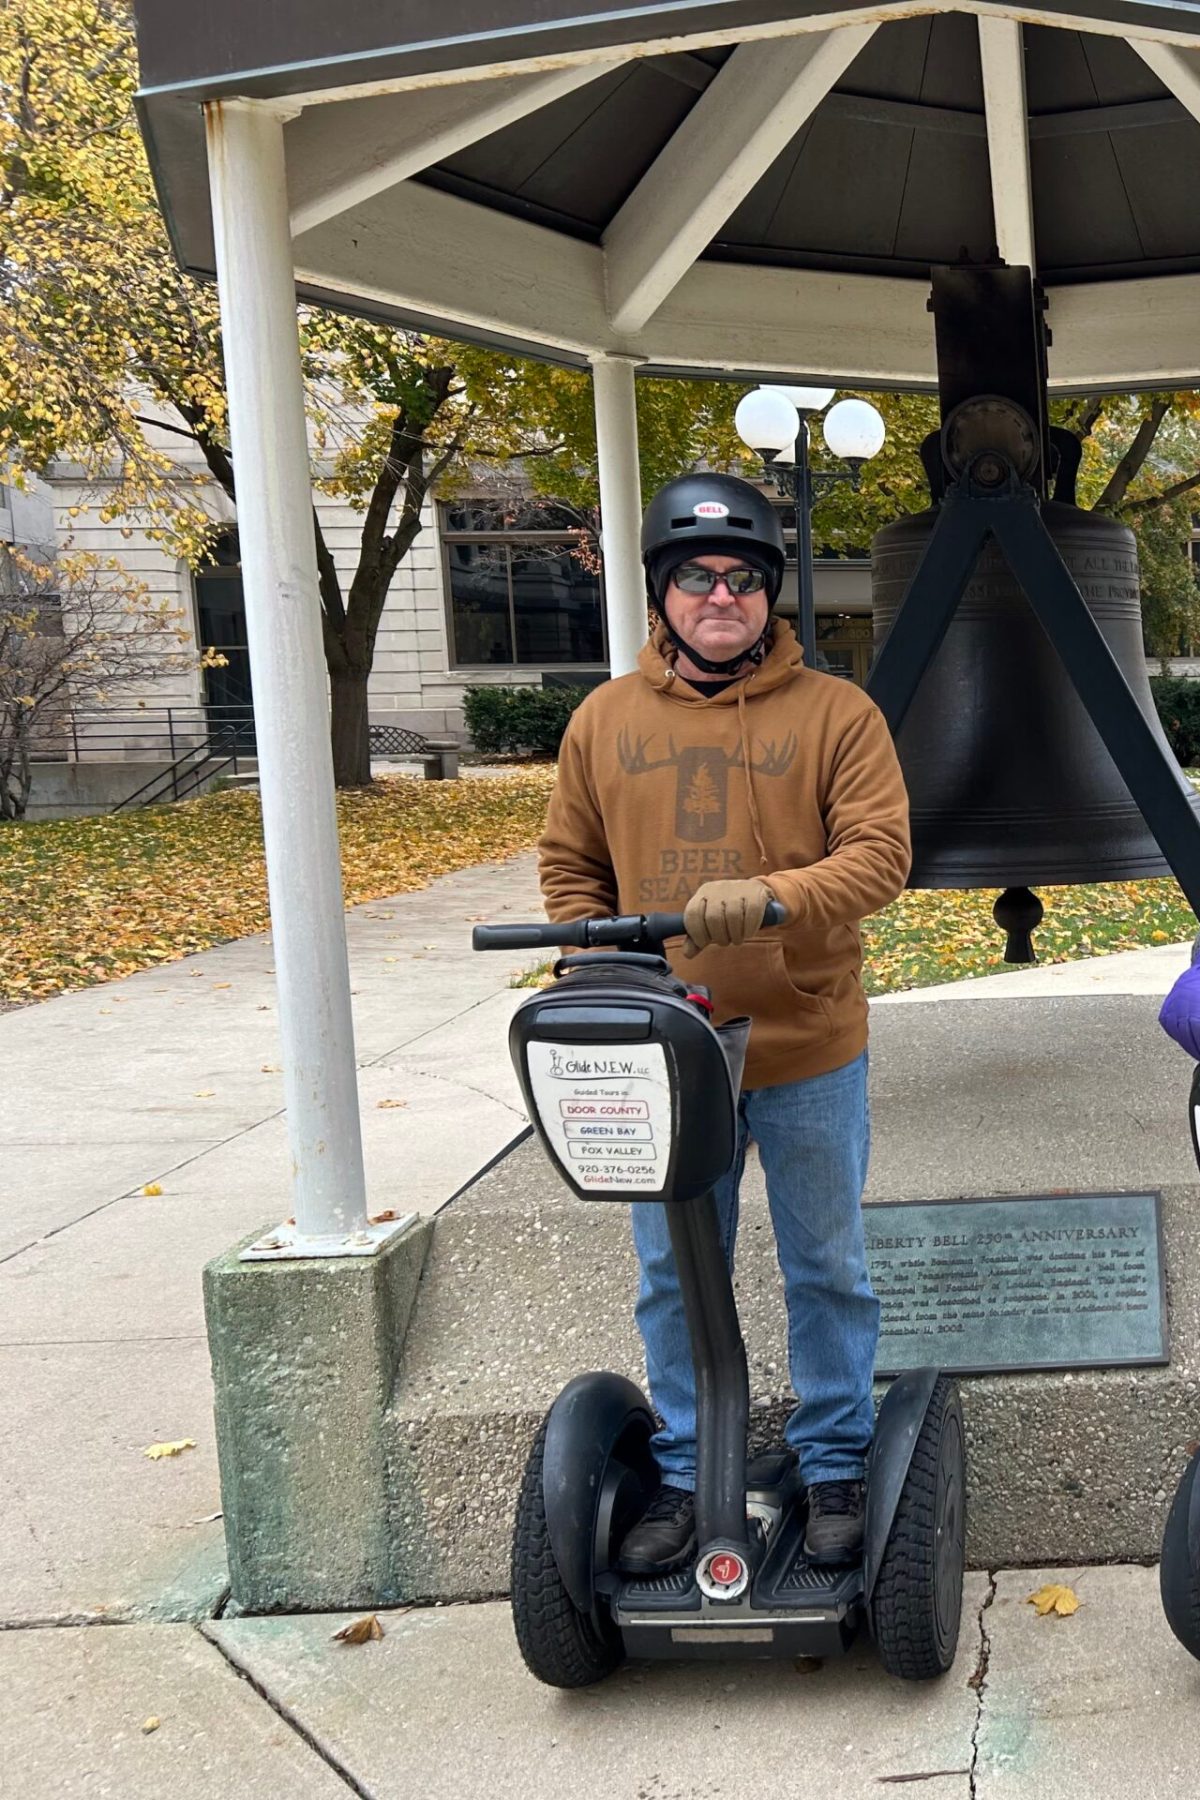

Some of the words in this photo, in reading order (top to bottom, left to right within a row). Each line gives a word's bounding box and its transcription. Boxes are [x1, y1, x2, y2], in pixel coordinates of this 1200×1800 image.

[1084, 557, 1108, 571] ALL
[660, 848, 743, 874] BEER
[565, 1060, 591, 1074] Glide
[567, 1106, 596, 1114] DOOR
[600, 1106, 642, 1115] COUNTY
[580, 1127, 613, 1135] GREEN
[617, 1127, 636, 1135] BAY
[581, 1146, 603, 1155] FOX
[606, 1146, 642, 1155] VALLEY
[578, 1165, 656, 1174] 920-376-0256
[584, 1175, 656, 1185] GlideNew.com
[933, 1234, 968, 1247] BELL
[1019, 1227, 1140, 1242] ANNIVERSARY
[900, 1259, 925, 1268] while
[931, 1257, 973, 1268] Benjamin
[980, 1253, 1019, 1265] Franklin
[1025, 1253, 1043, 1261] was
[1092, 1250, 1105, 1259] his
[1110, 1249, 1129, 1258] Plan
[1135, 1248, 1145, 1257] of
[894, 1273, 909, 1281] the
[917, 1270, 978, 1281] Pennsylvania
[1099, 1263, 1115, 1272] bell
[1124, 1262, 1146, 1271] from
[922, 1285, 939, 1294] Bell
[946, 1282, 986, 1293] Foundry
[991, 1282, 1000, 1290] of
[1006, 1280, 1043, 1290] London,
[912, 1300, 929, 1308] was
[936, 1296, 981, 1307] described
[988, 1296, 997, 1304] as
[915, 1311, 937, 1321] from
[942, 1310, 957, 1319] the
[962, 1310, 985, 1319] same
[989, 1307, 1026, 1318] foundry
[1032, 1306, 1048, 1315] and
[1052, 1306, 1070, 1314] was
[1075, 1303, 1121, 1313] dedicated
